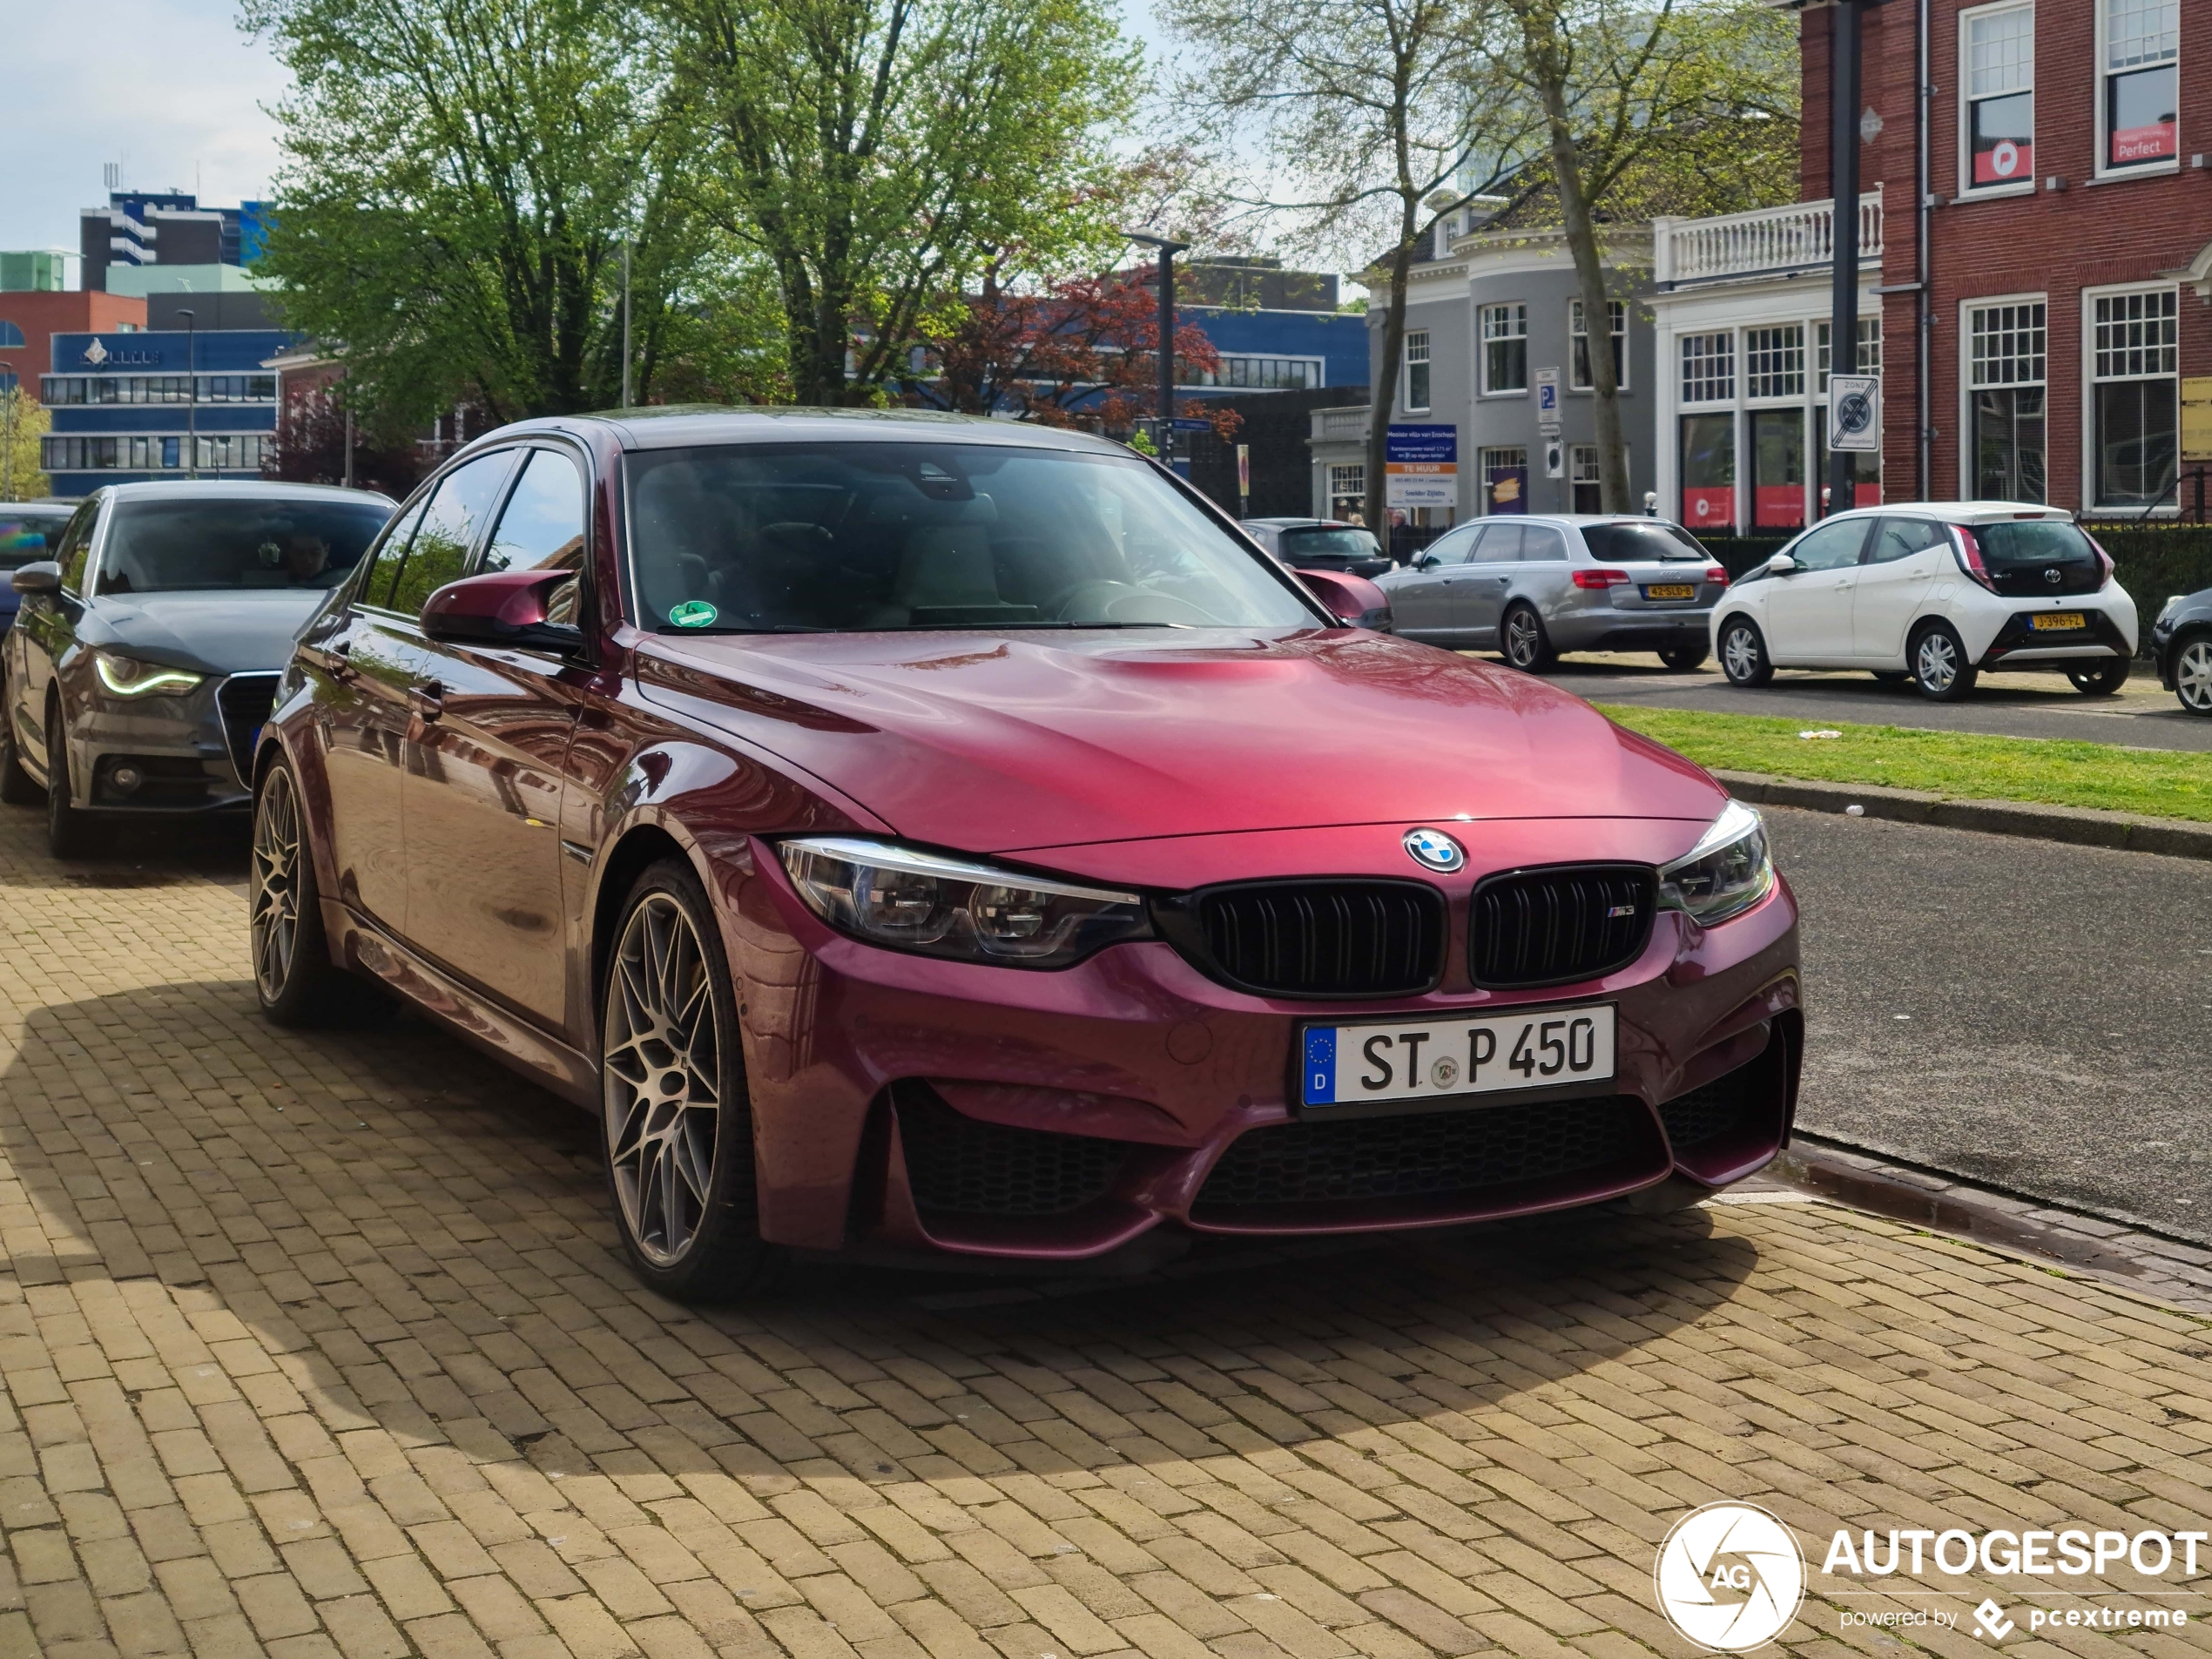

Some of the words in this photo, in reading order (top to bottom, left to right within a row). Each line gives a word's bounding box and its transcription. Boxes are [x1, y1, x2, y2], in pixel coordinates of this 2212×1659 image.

[2119, 141, 2161, 157] Perfect
[1404, 464, 1415, 473] TE
[1417, 464, 1440, 473] HUUR
[1651, 586, 1692, 597] 42-SLD-8
[2039, 615, 2080, 627] J-396-FZ
[1361, 1032, 1430, 1090] ST
[1468, 1028, 1497, 1083] P
[1509, 1017, 1595, 1078] 450
[1314, 1074, 1325, 1089] D
